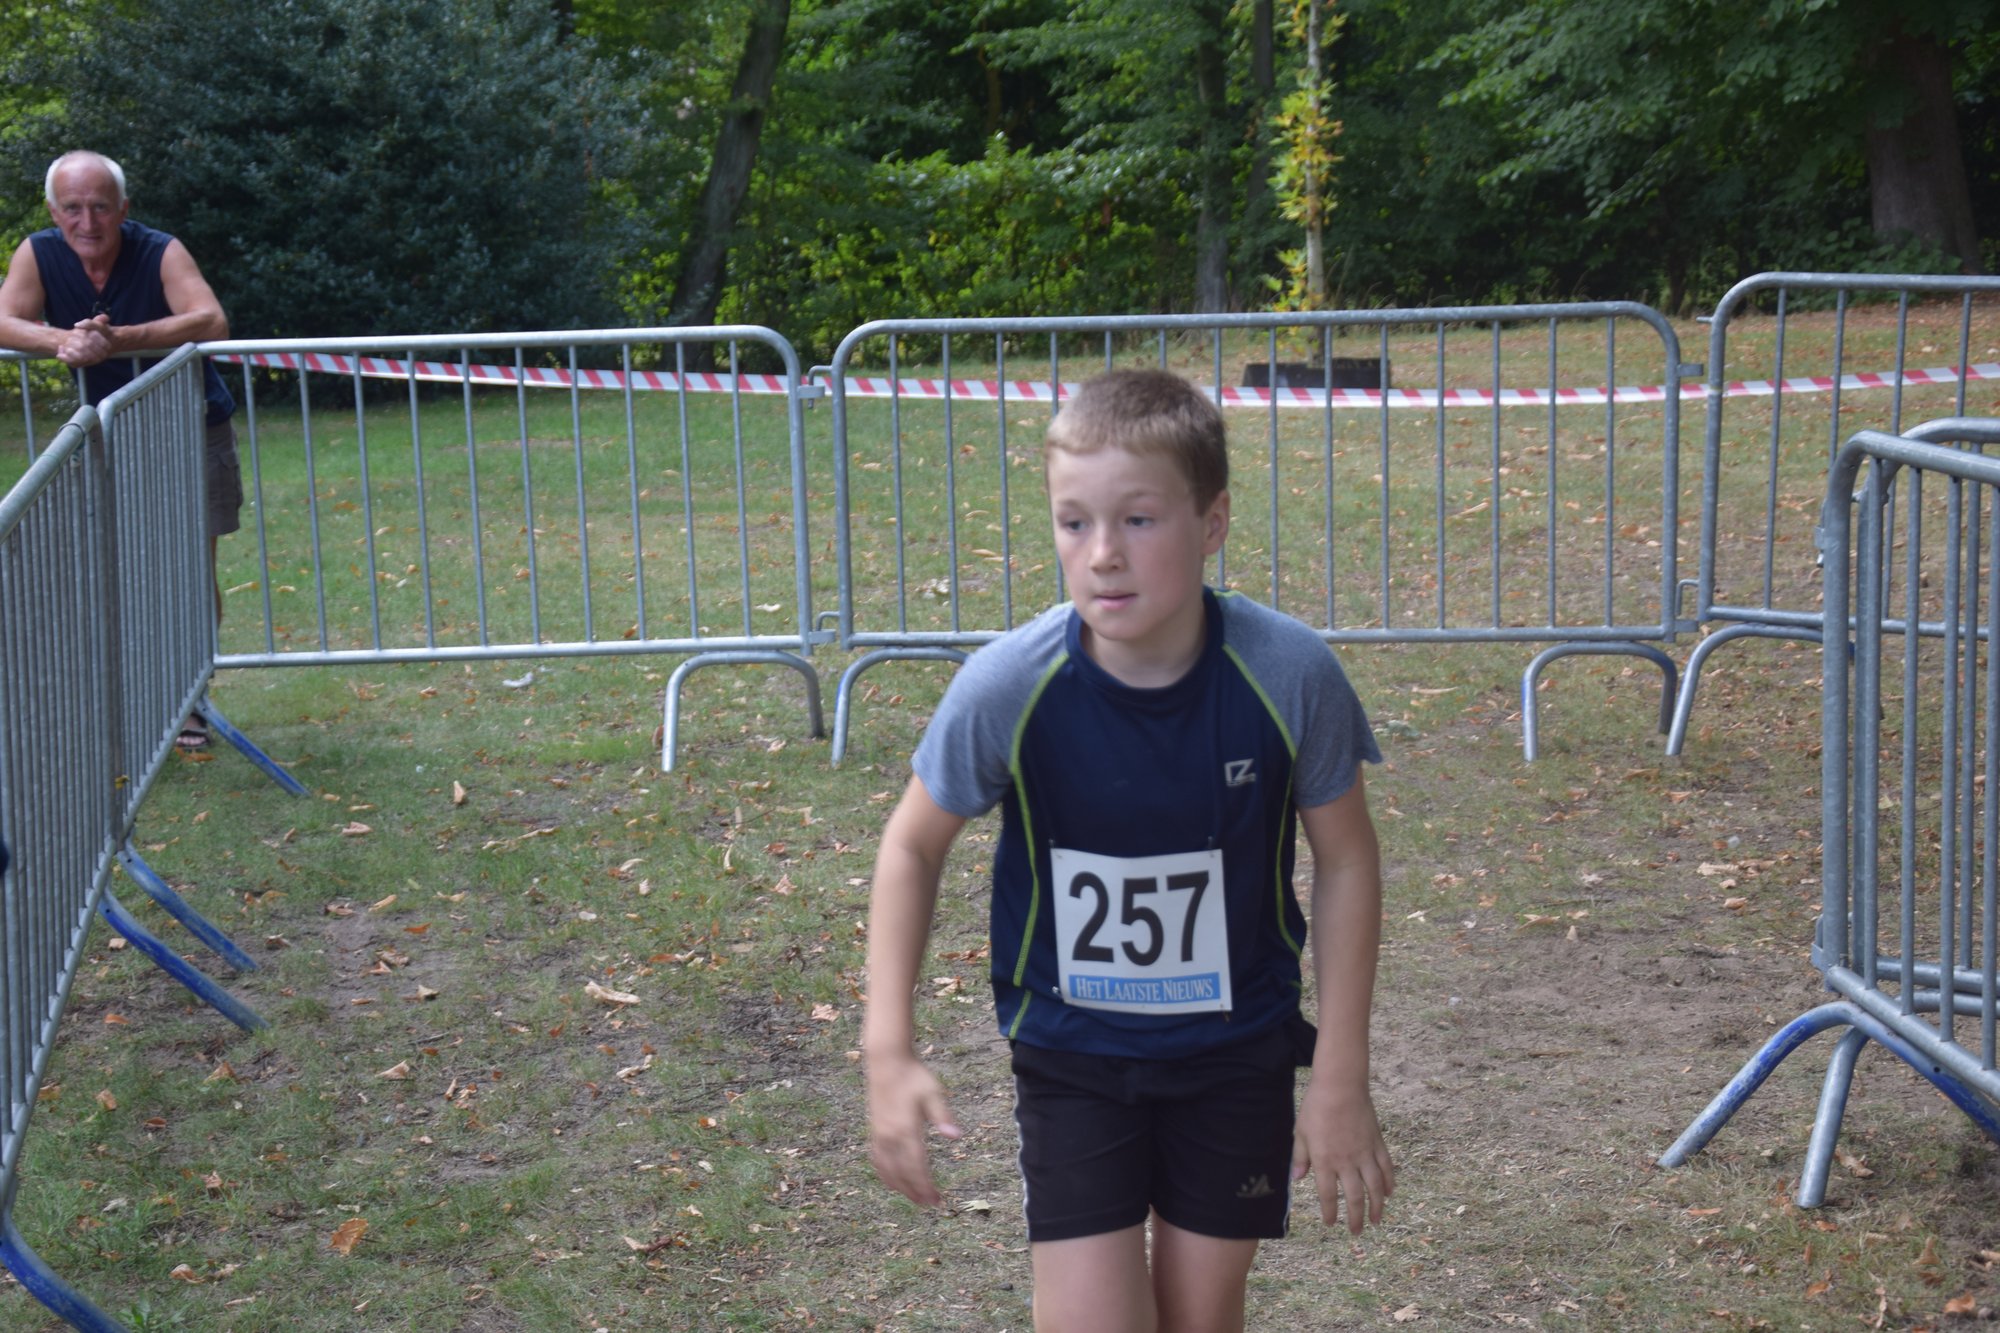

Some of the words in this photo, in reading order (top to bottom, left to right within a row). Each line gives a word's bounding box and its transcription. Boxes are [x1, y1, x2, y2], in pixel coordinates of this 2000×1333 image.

[1069, 870, 1210, 967] 257
[1075, 976, 1103, 999] HET
[1104, 978, 1160, 1002] LAATSTE
[1163, 978, 1213, 1002] NIEUWS
